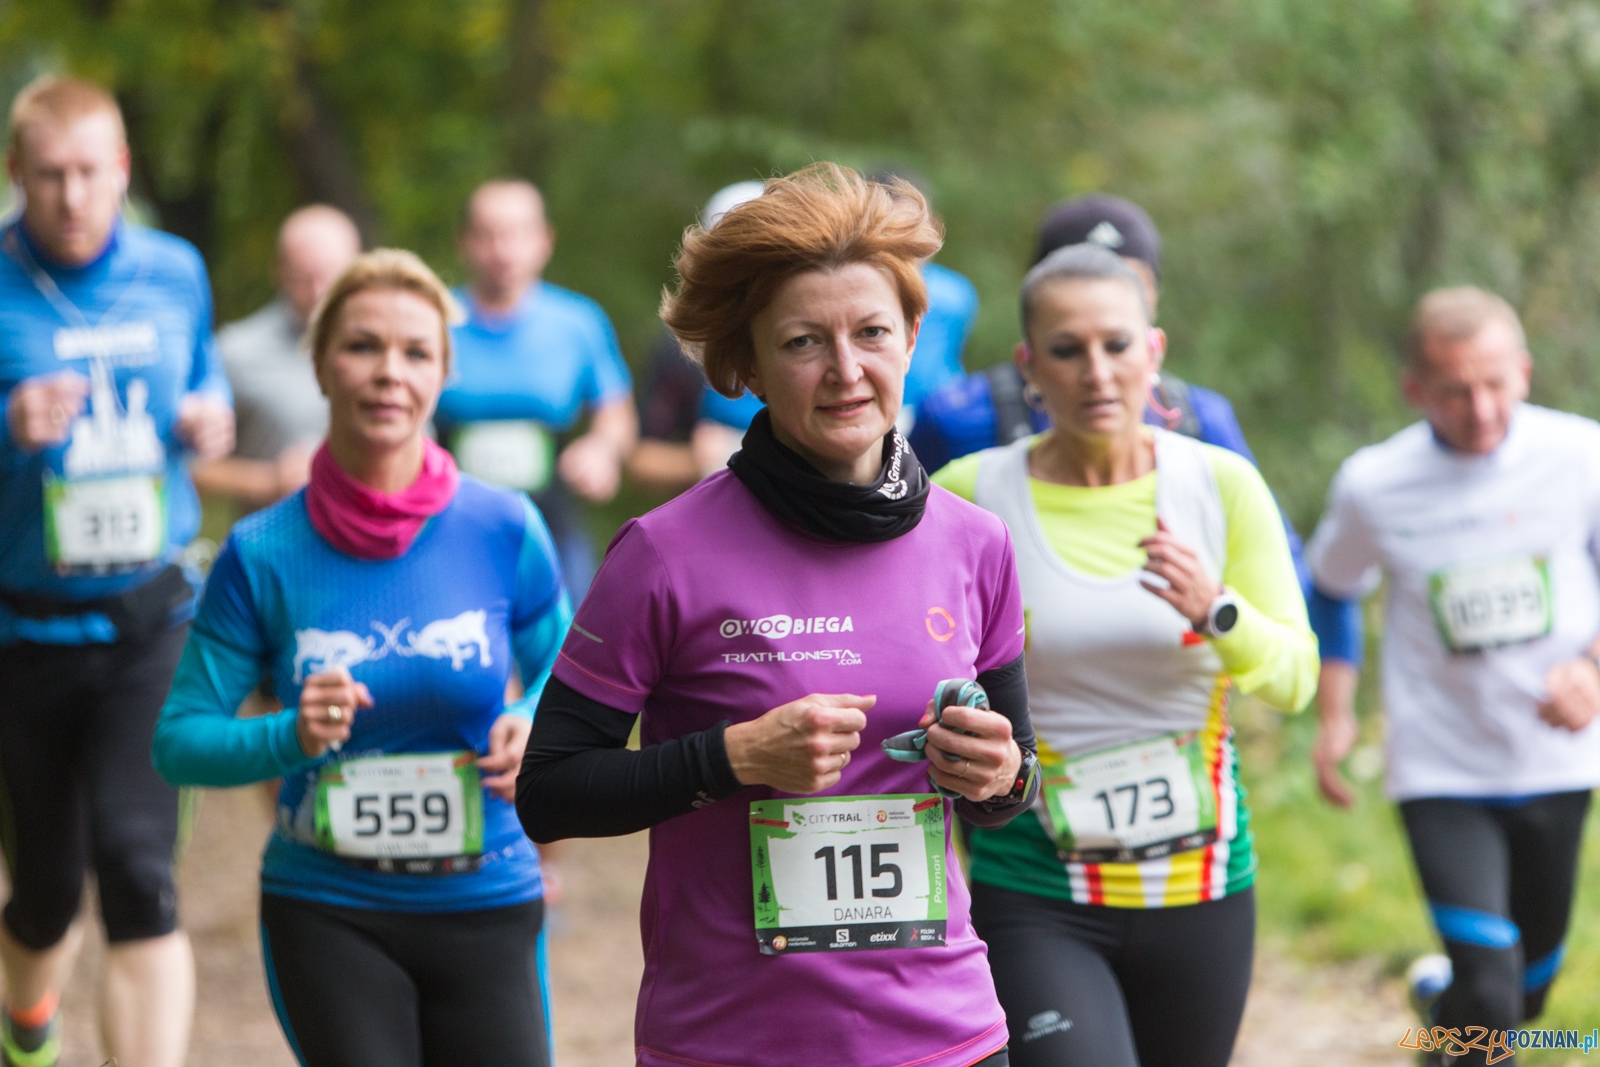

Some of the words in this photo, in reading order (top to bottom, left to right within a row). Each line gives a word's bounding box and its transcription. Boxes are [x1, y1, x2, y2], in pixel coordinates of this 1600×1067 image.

[721, 649, 855, 663] TRIATHLONISTA
[354, 793, 451, 837] 559
[1094, 777, 1176, 831] 173
[814, 843, 903, 901] 115
[933, 854, 943, 904] Poznań
[834, 906, 893, 921] DANARA
